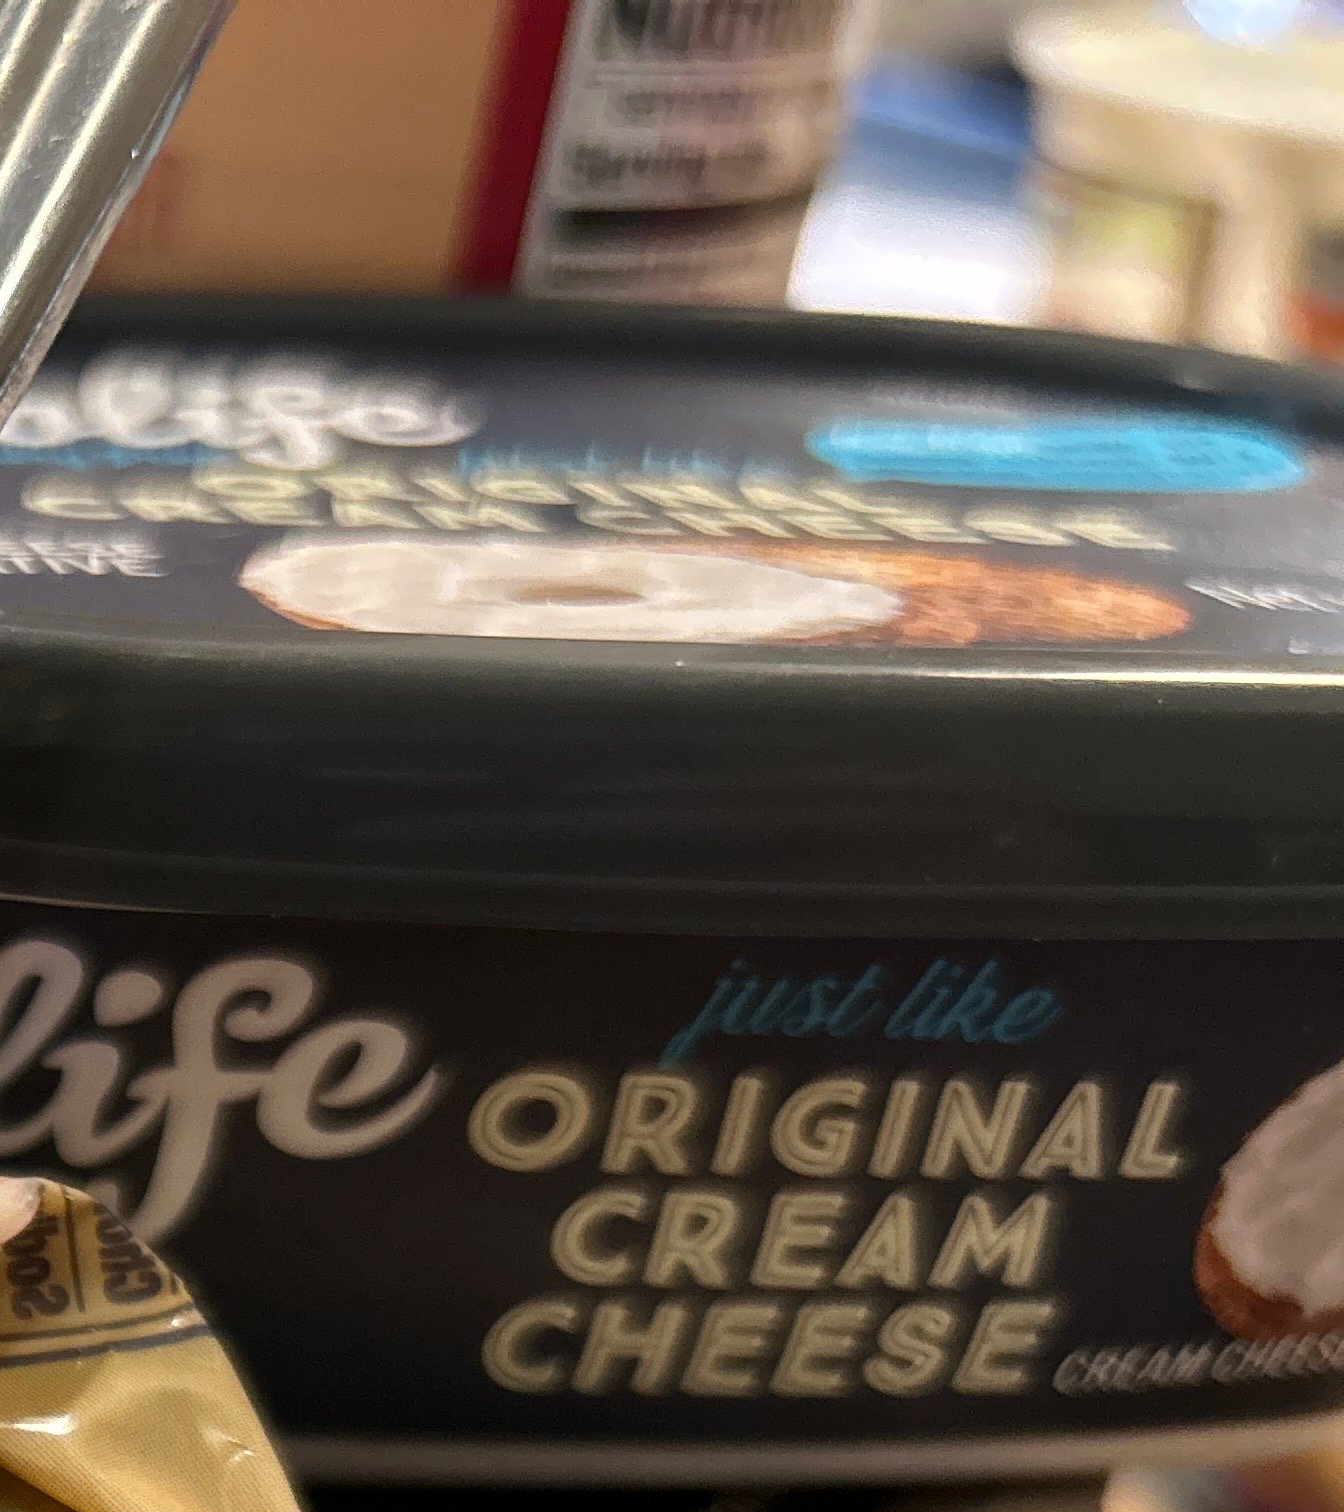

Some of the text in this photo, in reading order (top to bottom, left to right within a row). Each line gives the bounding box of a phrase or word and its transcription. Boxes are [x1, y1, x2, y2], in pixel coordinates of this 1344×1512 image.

[656, 957, 1062, 1068] just like
[468, 1071, 1184, 1181] ORIGINAL
[550, 1190, 1054, 1290] CREAM
[483, 1299, 1062, 1397] CHEESE
[1053, 1343, 1214, 1396] CREAM
